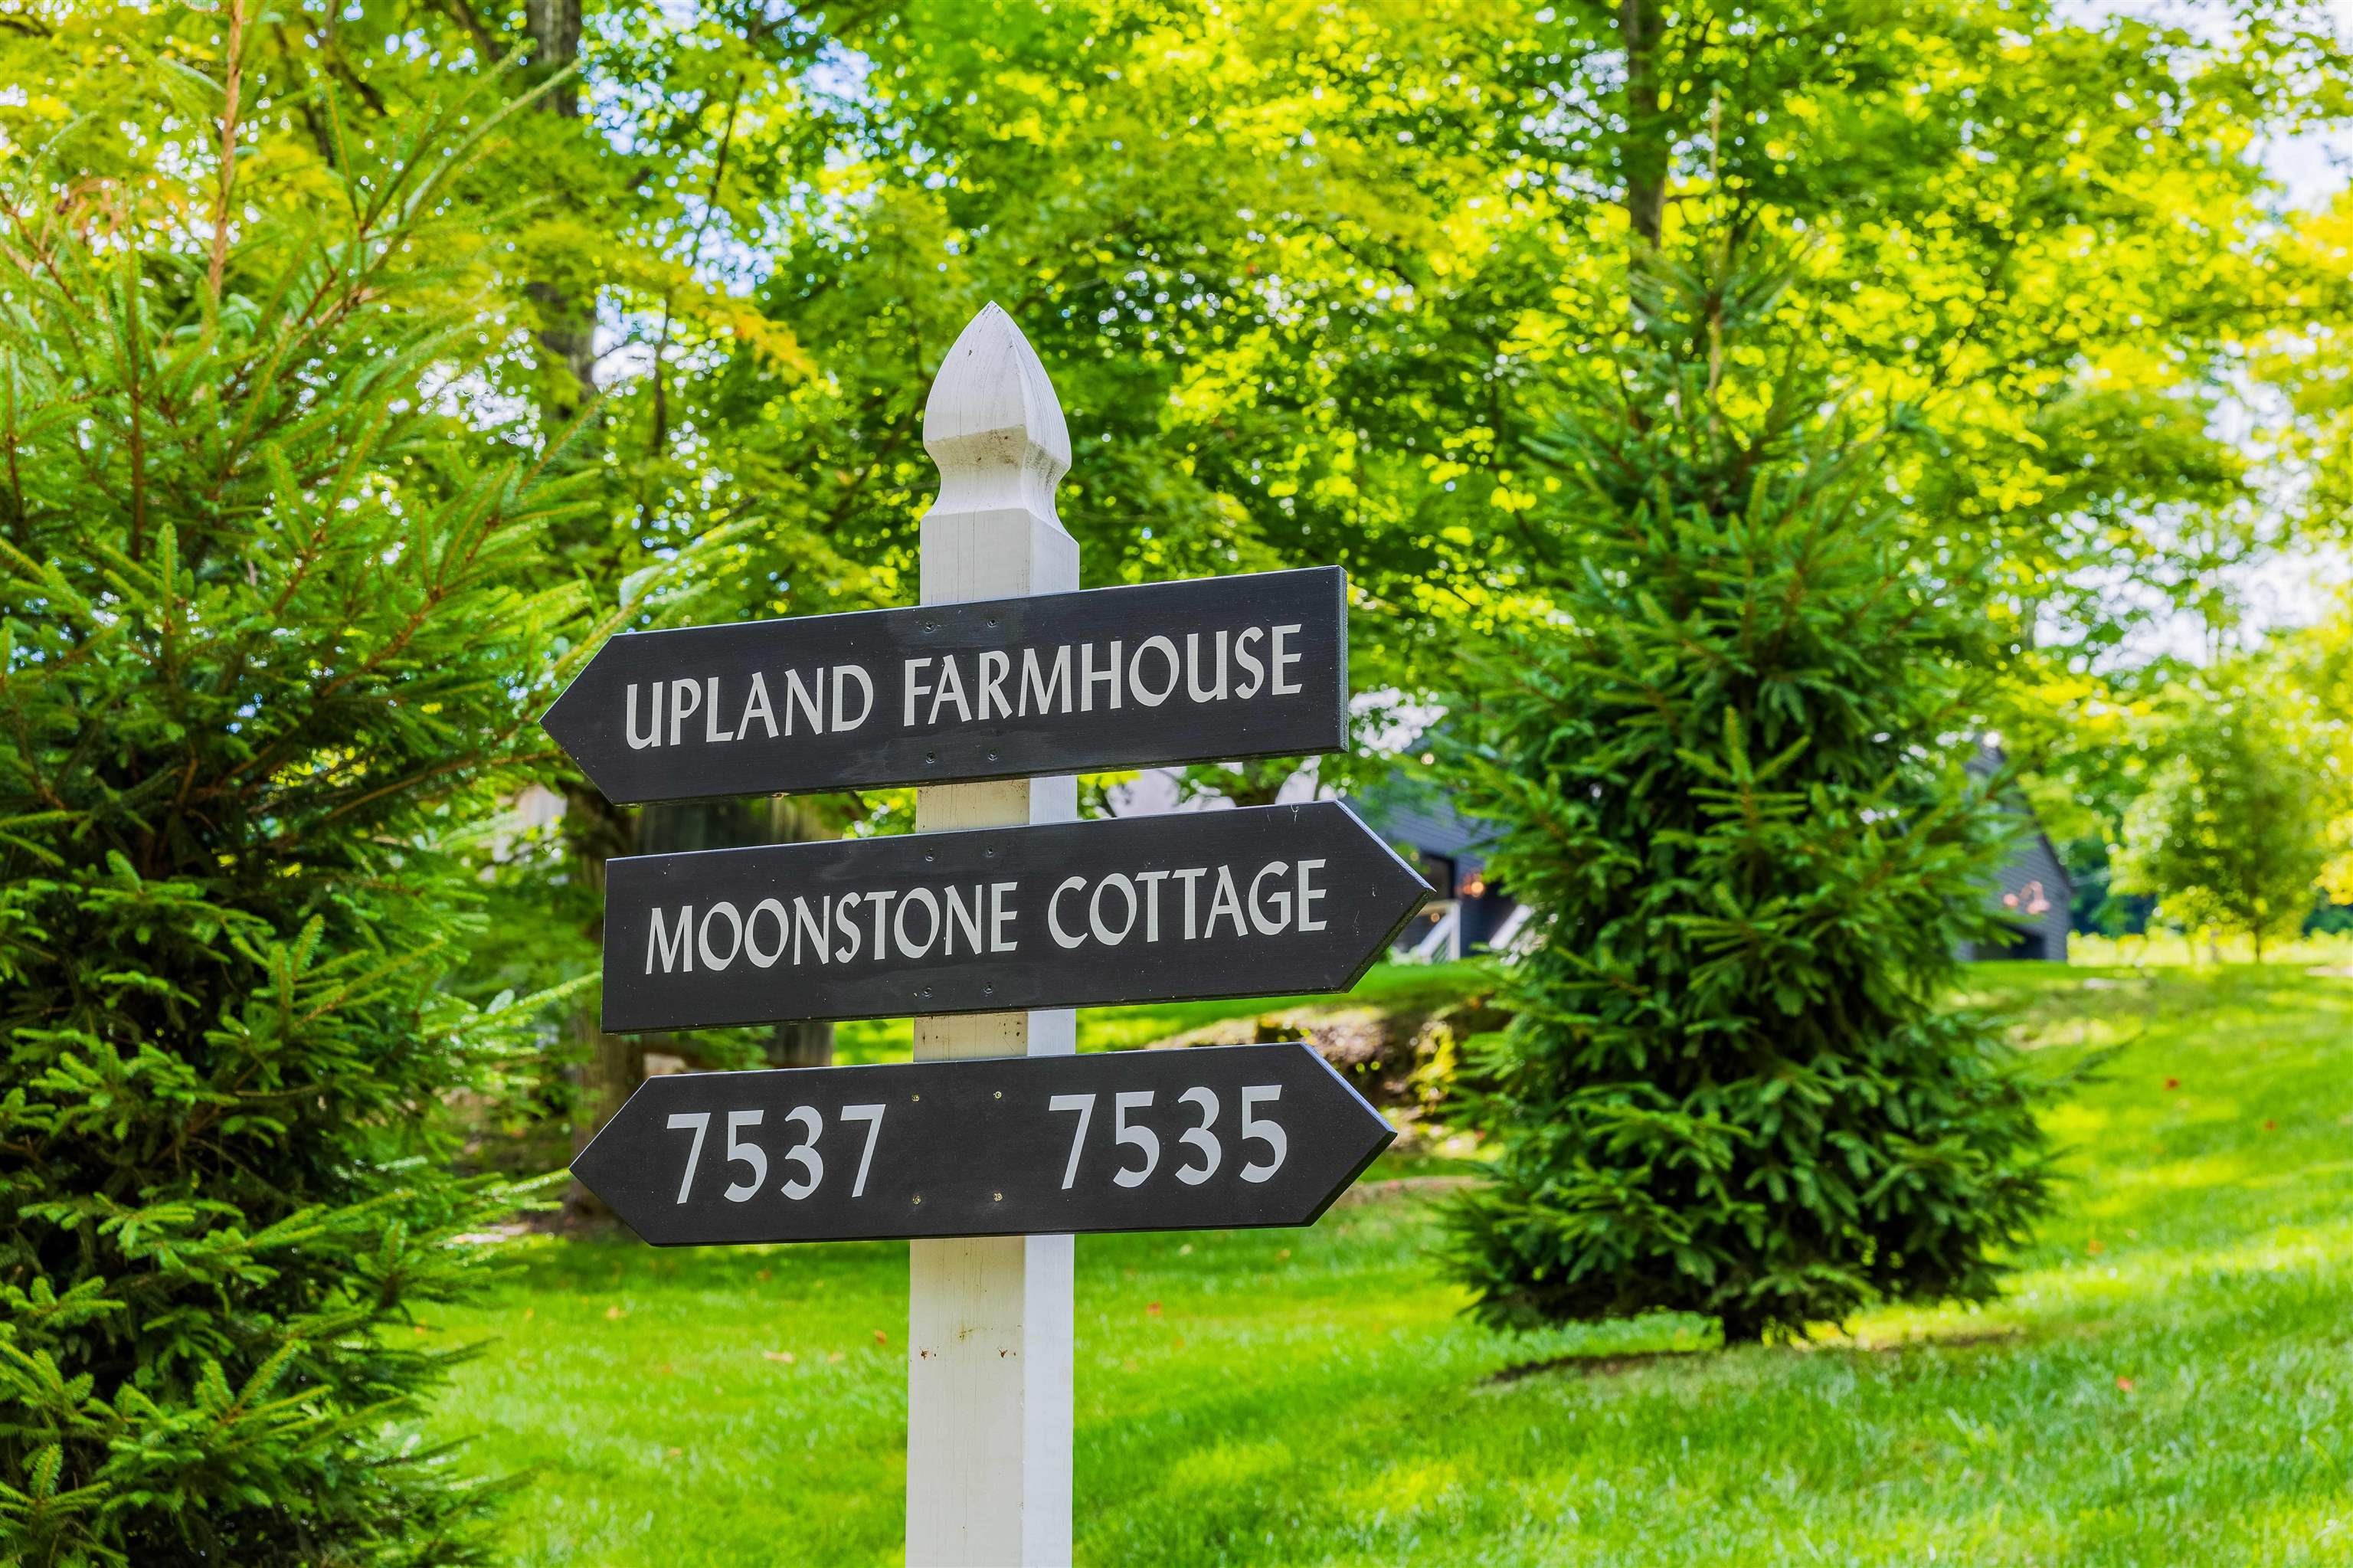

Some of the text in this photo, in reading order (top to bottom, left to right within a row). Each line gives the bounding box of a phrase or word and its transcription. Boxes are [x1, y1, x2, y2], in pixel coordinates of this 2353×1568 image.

[626, 624, 1303, 750] UPLAND FARMHOUSE
[645, 859, 1327, 975] MOONSTONE COTTAGE
[666, 1084, 1288, 1205] 7537 7535
